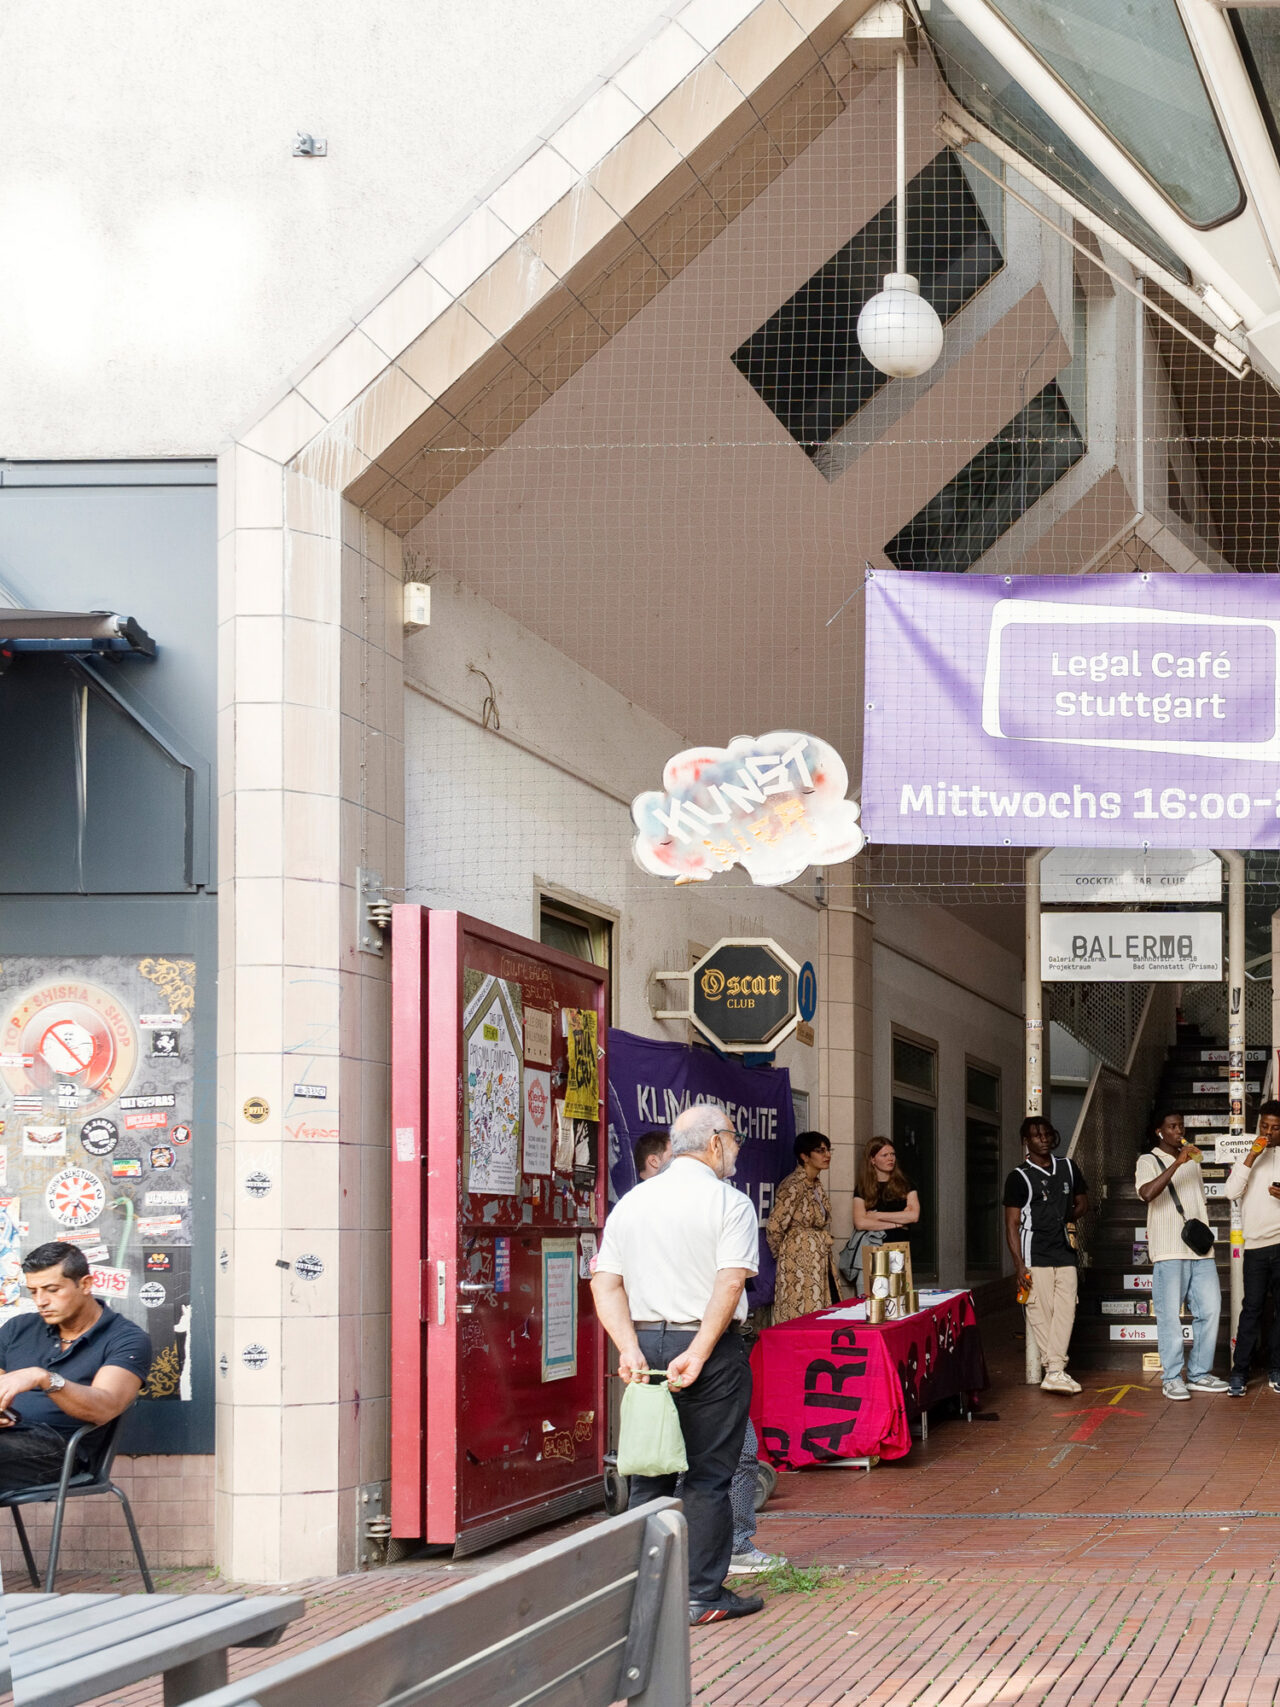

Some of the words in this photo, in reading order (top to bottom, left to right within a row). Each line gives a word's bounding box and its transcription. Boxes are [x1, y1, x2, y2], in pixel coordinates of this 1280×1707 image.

[1051, 650, 1142, 682] Legal
[1151, 649, 1231, 680] Café
[1055, 691, 1226, 724] Stuttgart
[652, 738, 815, 844] KUNST
[899, 783, 1122, 821] Mittwochs
[1048, 963, 1092, 971] Projektraum
[1188, 963, 1219, 971] (Prisma)
[701, 969, 782, 1001] Oscar
[33, 986, 89, 1007] SHISHA
[104, 1004, 131, 1048] SHOP
[726, 998, 756, 1009] CLUB
[1219, 1139, 1254, 1147] Common
[1230, 1147, 1250, 1155] Kitch
[1128, 1329, 1146, 1339] vhs
